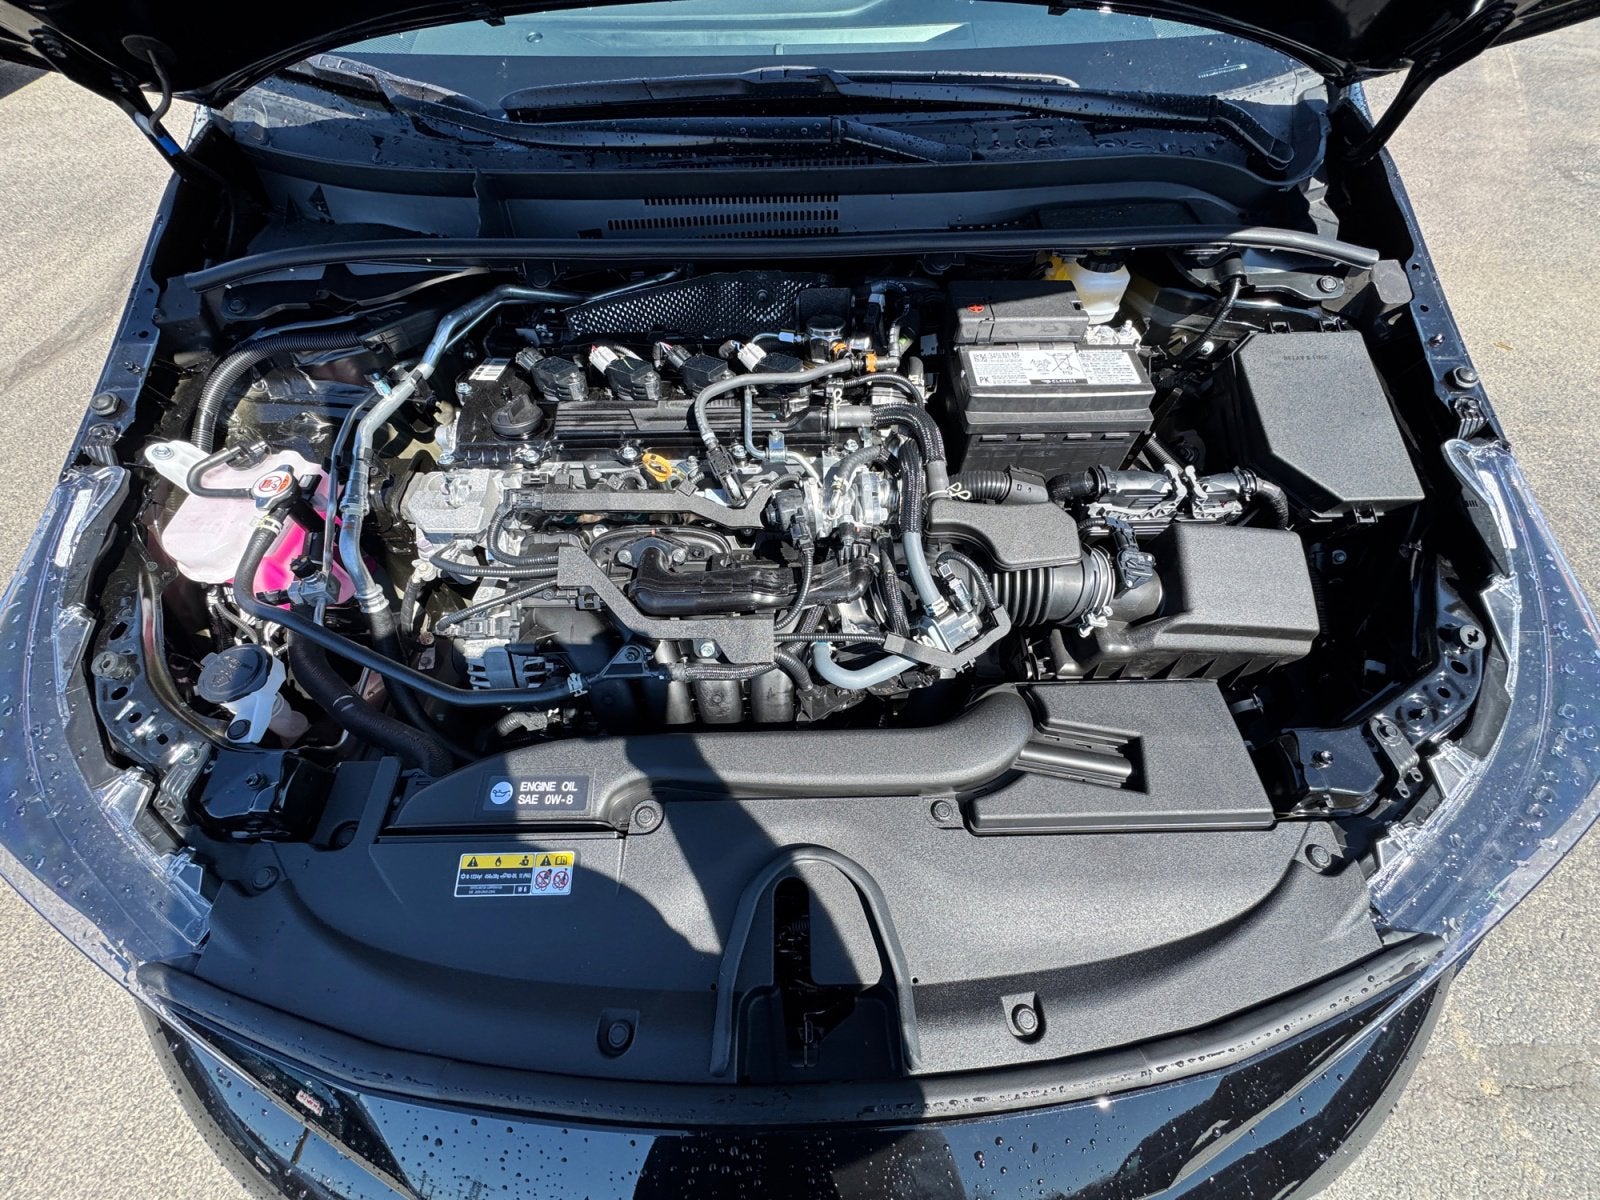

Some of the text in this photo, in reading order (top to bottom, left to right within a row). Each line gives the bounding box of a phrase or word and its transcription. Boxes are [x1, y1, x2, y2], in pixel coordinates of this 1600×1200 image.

[979, 376, 990, 384] PK
[519, 781, 578, 792] ENGINE OIL
[517, 793, 574, 805] SAE 0W-8
